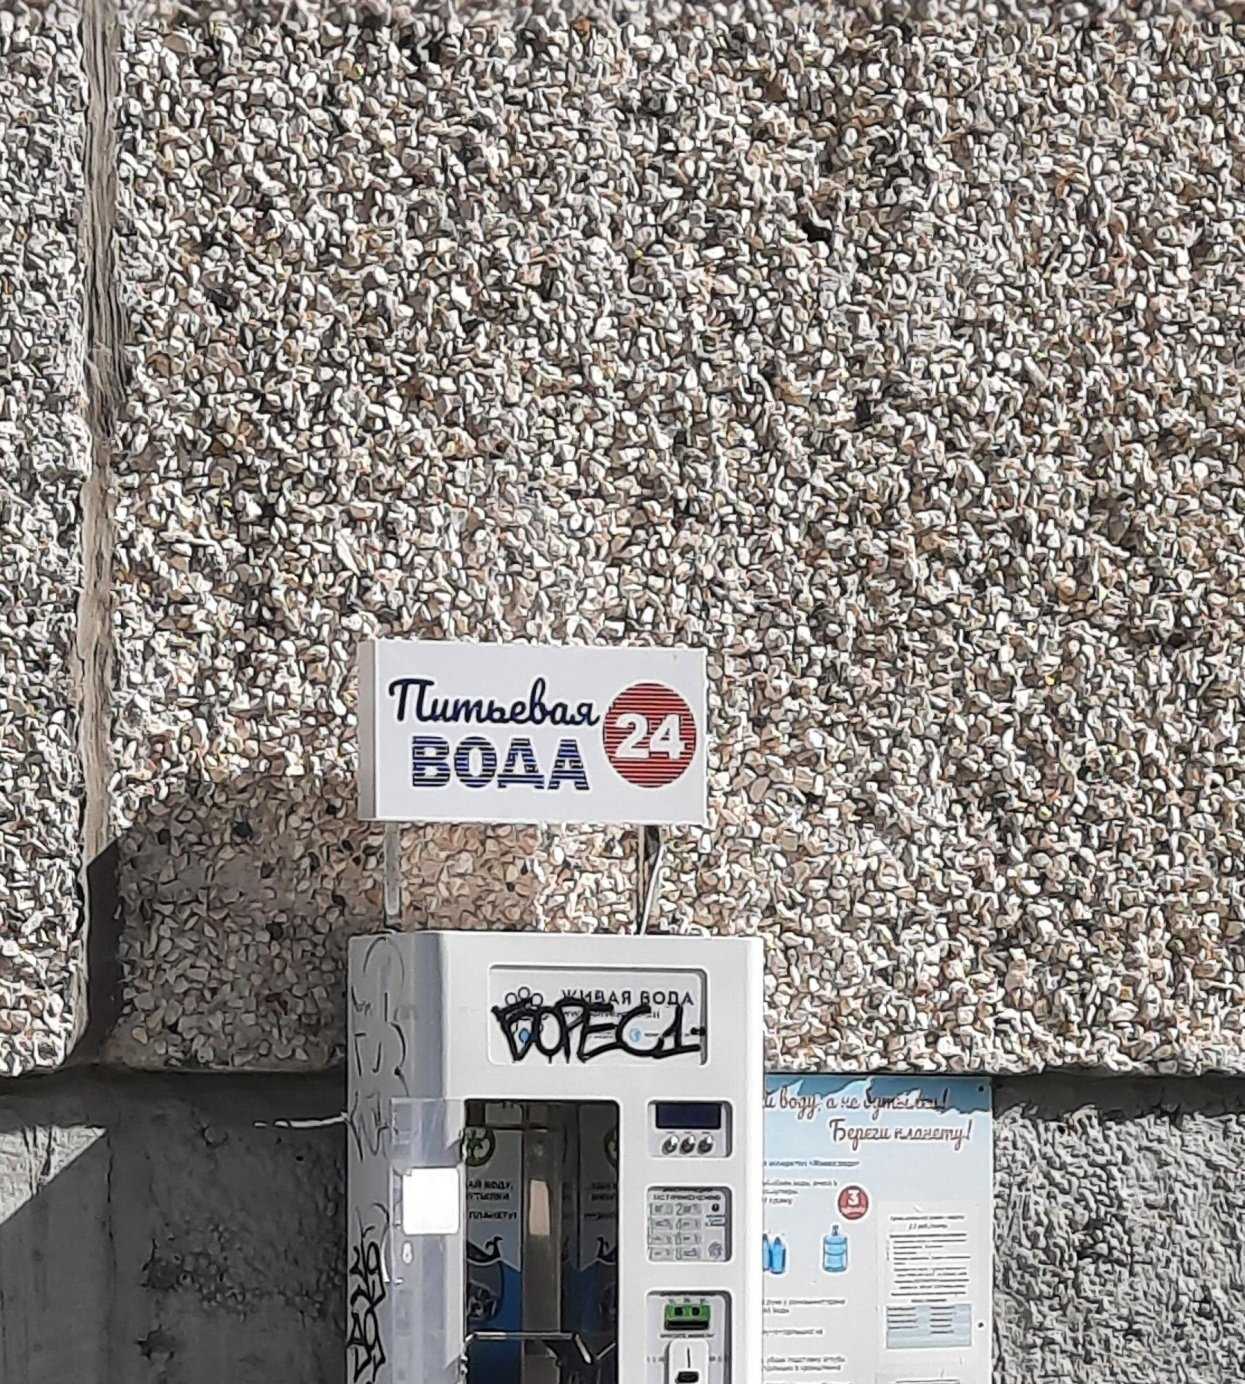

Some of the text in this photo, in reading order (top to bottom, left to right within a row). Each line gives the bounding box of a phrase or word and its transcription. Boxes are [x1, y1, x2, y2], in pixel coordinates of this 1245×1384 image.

[388, 677, 600, 727] Питьевая
[614, 713, 686, 761] 24
[411, 735, 590, 791] ВОДА
[639, 990, 695, 1006] ВОДА
[829, 1118, 973, 1151] Береги планету!
